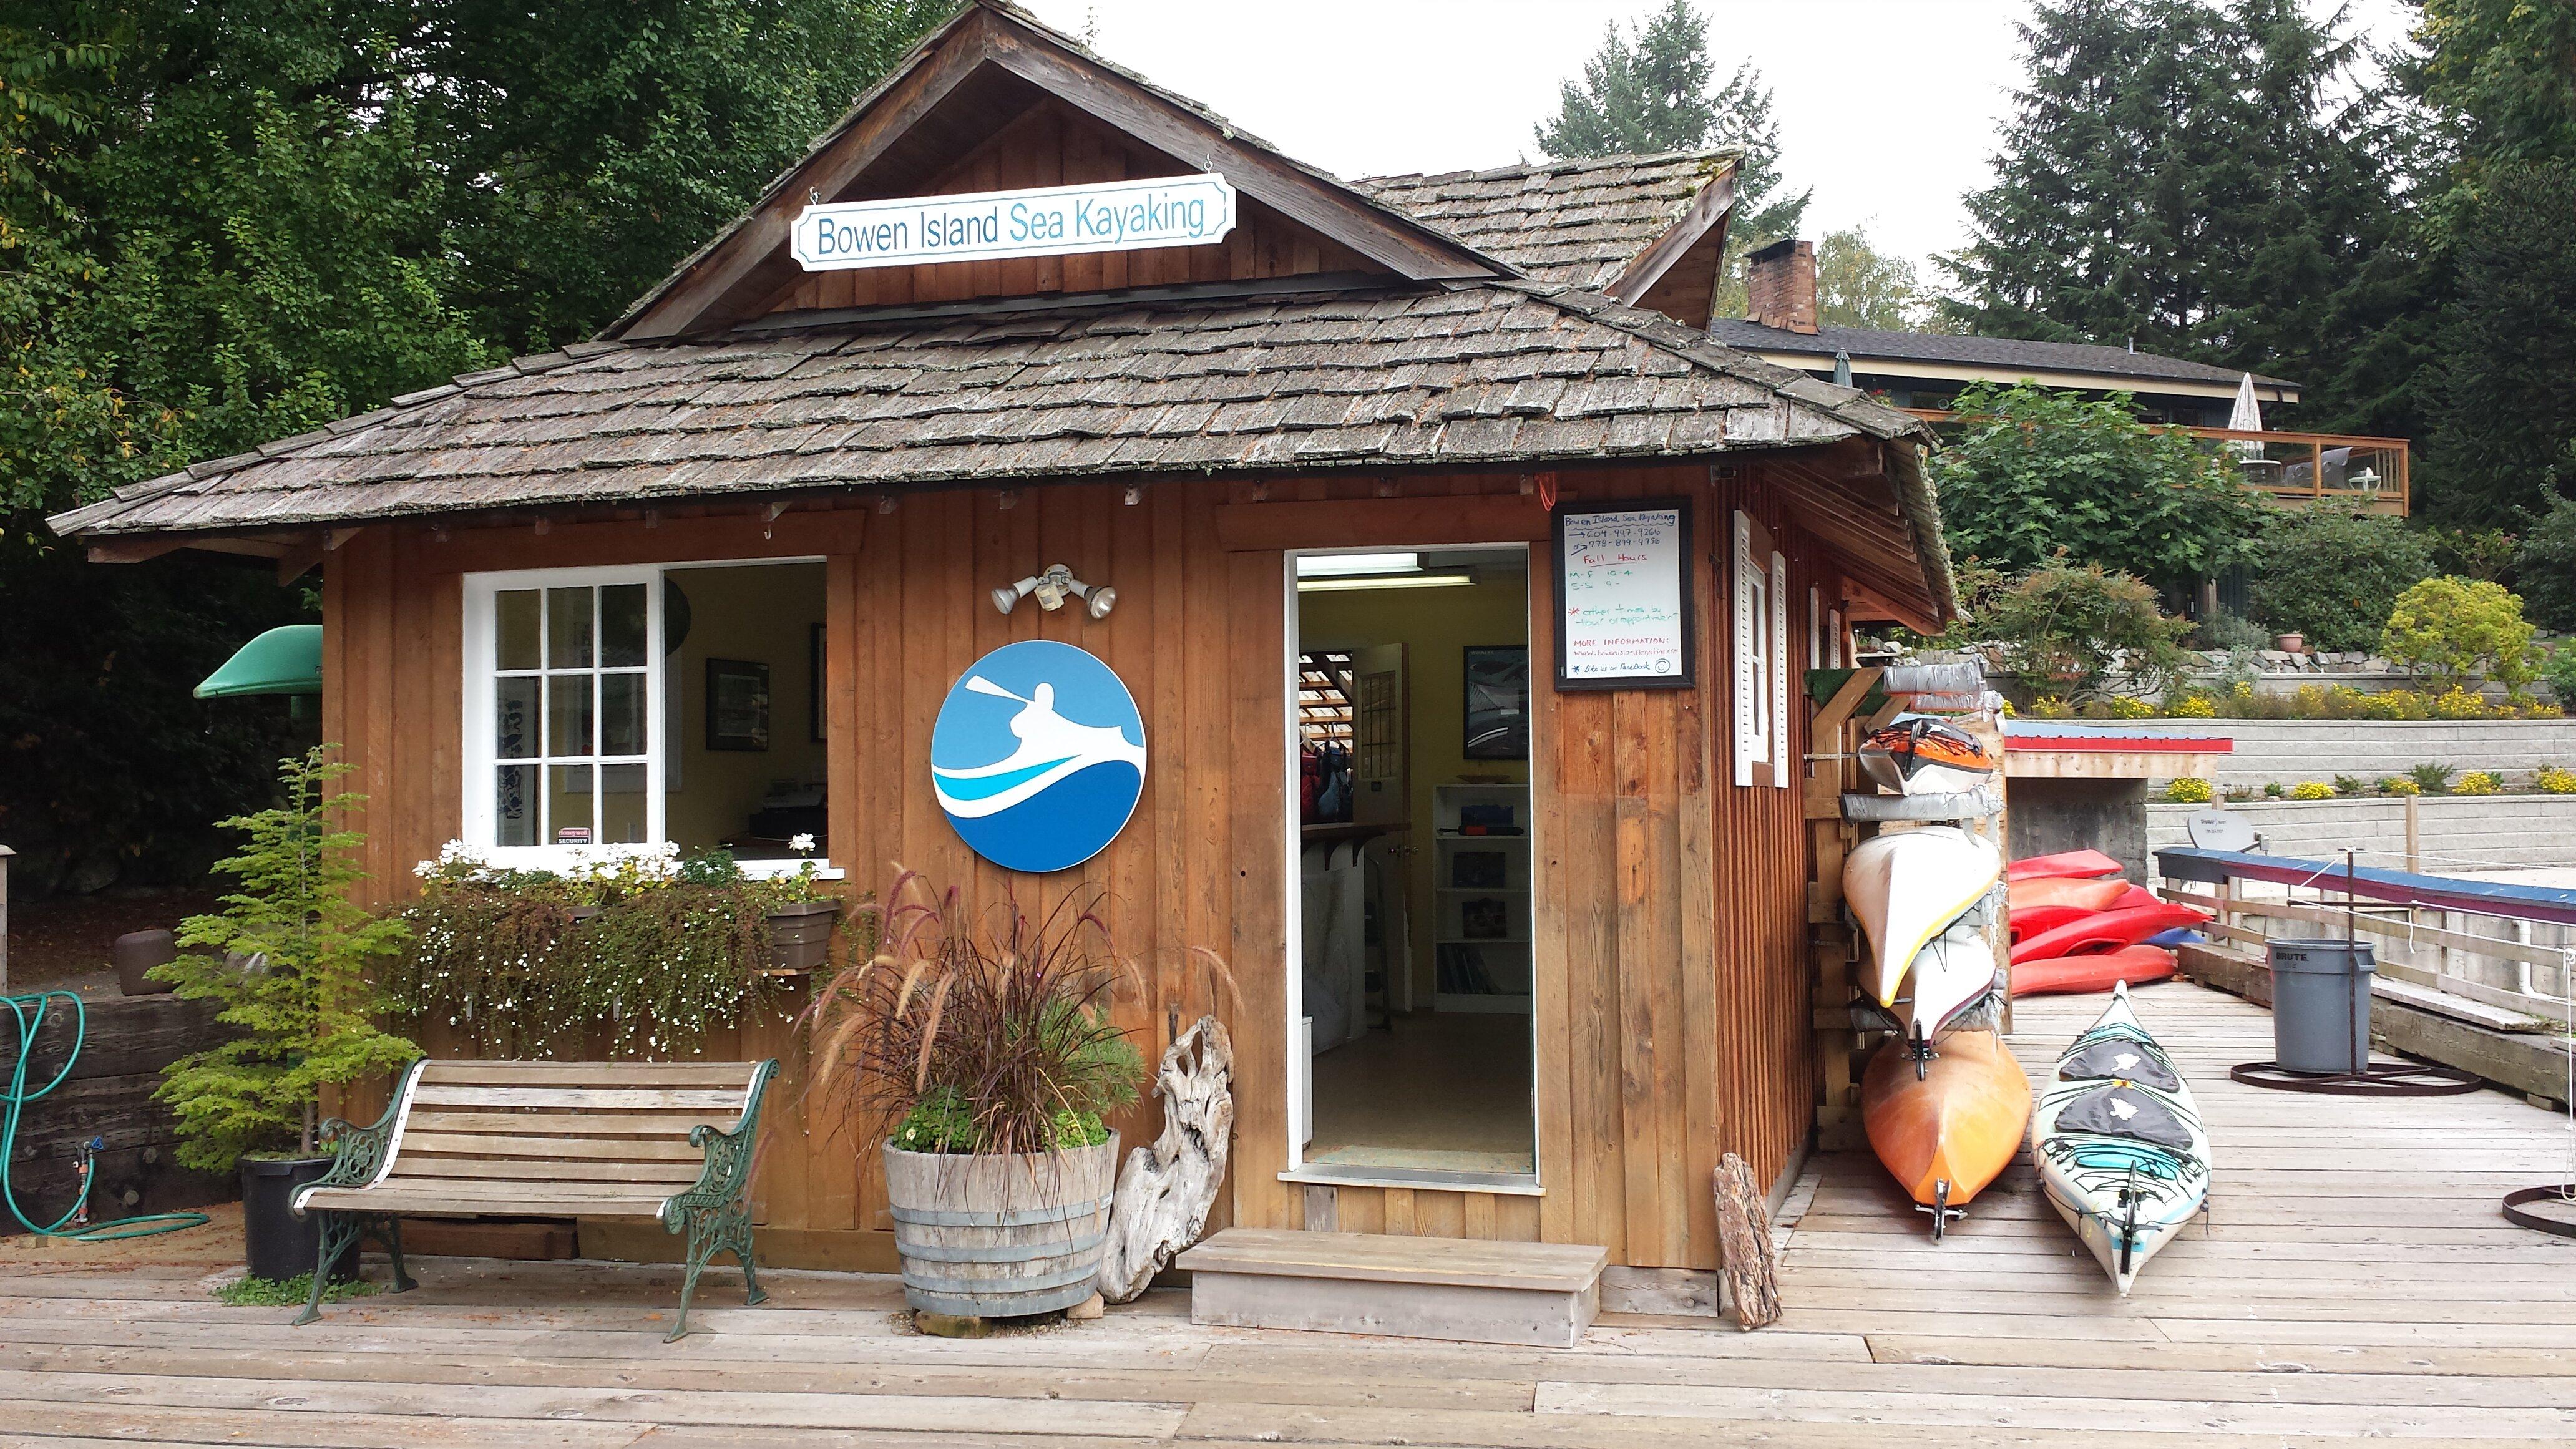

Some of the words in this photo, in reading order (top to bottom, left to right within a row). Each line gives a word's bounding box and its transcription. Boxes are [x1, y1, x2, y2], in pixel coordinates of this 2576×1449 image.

[819, 218, 908, 255] Bowen
[920, 206, 998, 248] Island
[1010, 203, 1063, 242] Sea
[1076, 192, 1204, 245] Kayaking
[1565, 517, 1591, 526] Bowen
[1593, 515, 1619, 524] Island
[1583, 554, 1604, 564] Fall
[1618, 553, 1647, 561] Hours
[1584, 665, 1598, 673] Like
[2276, 952, 2308, 961] BRUTE
